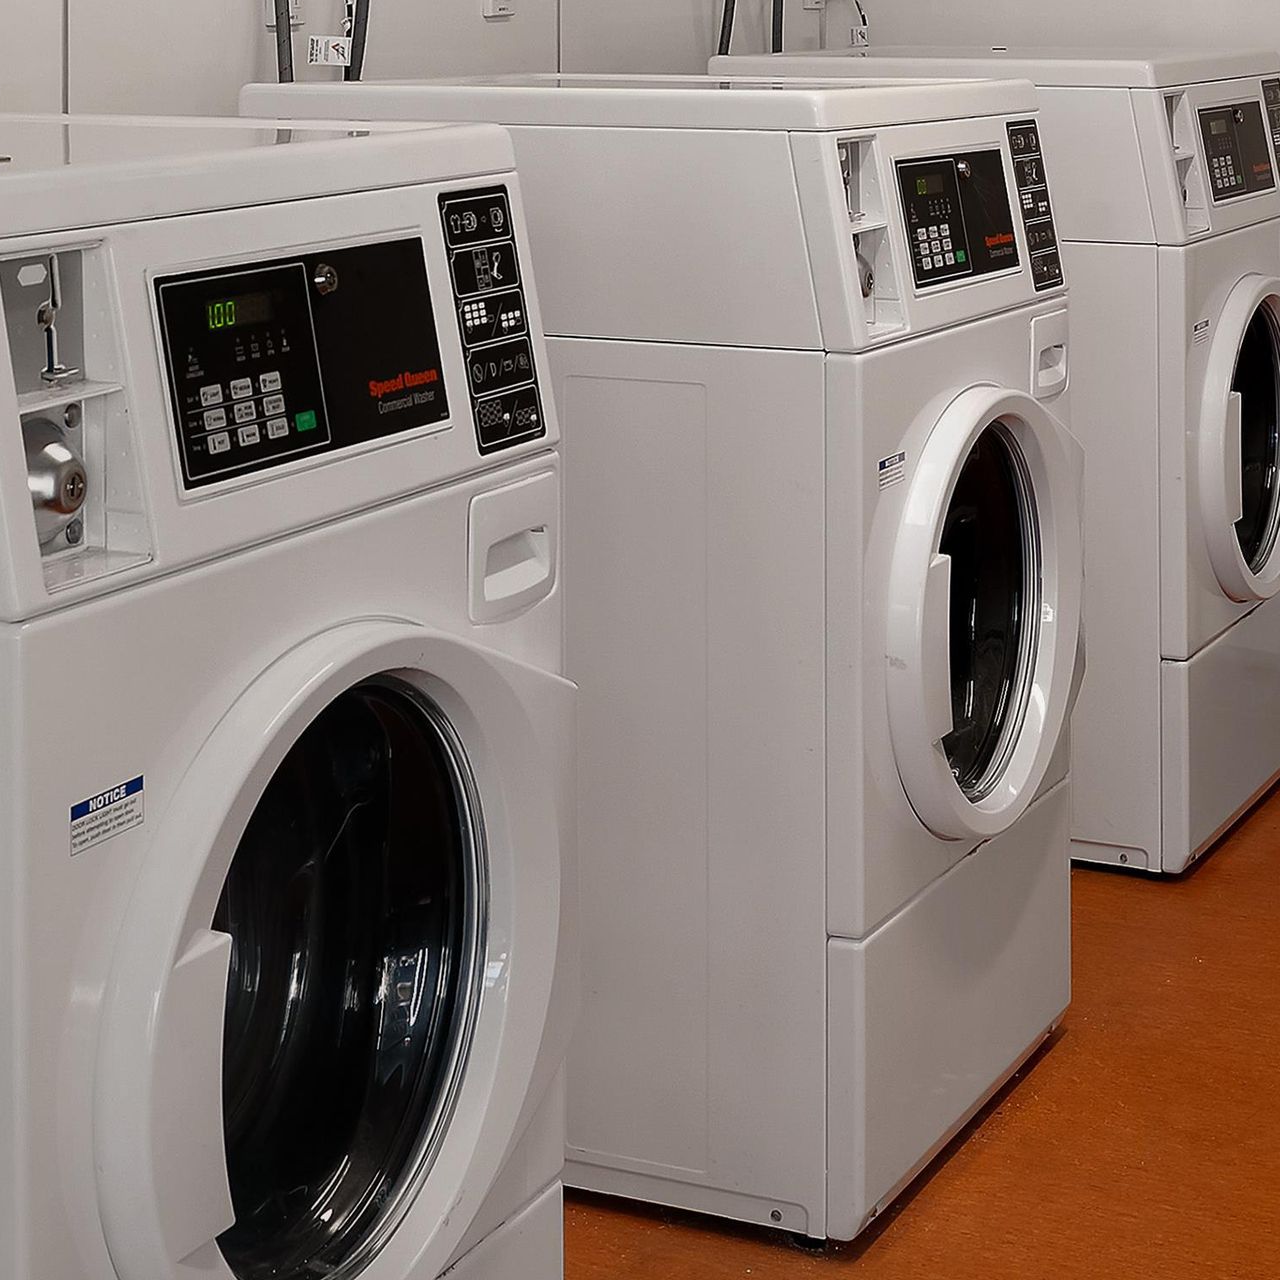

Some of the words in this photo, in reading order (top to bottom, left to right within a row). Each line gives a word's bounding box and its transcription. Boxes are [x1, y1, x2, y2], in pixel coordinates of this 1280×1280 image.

[369, 372, 403, 398] Speed
[405, 369, 438, 388] Queen
[378, 394, 413, 415] Commercial
[89, 785, 127, 812] NOTICE
